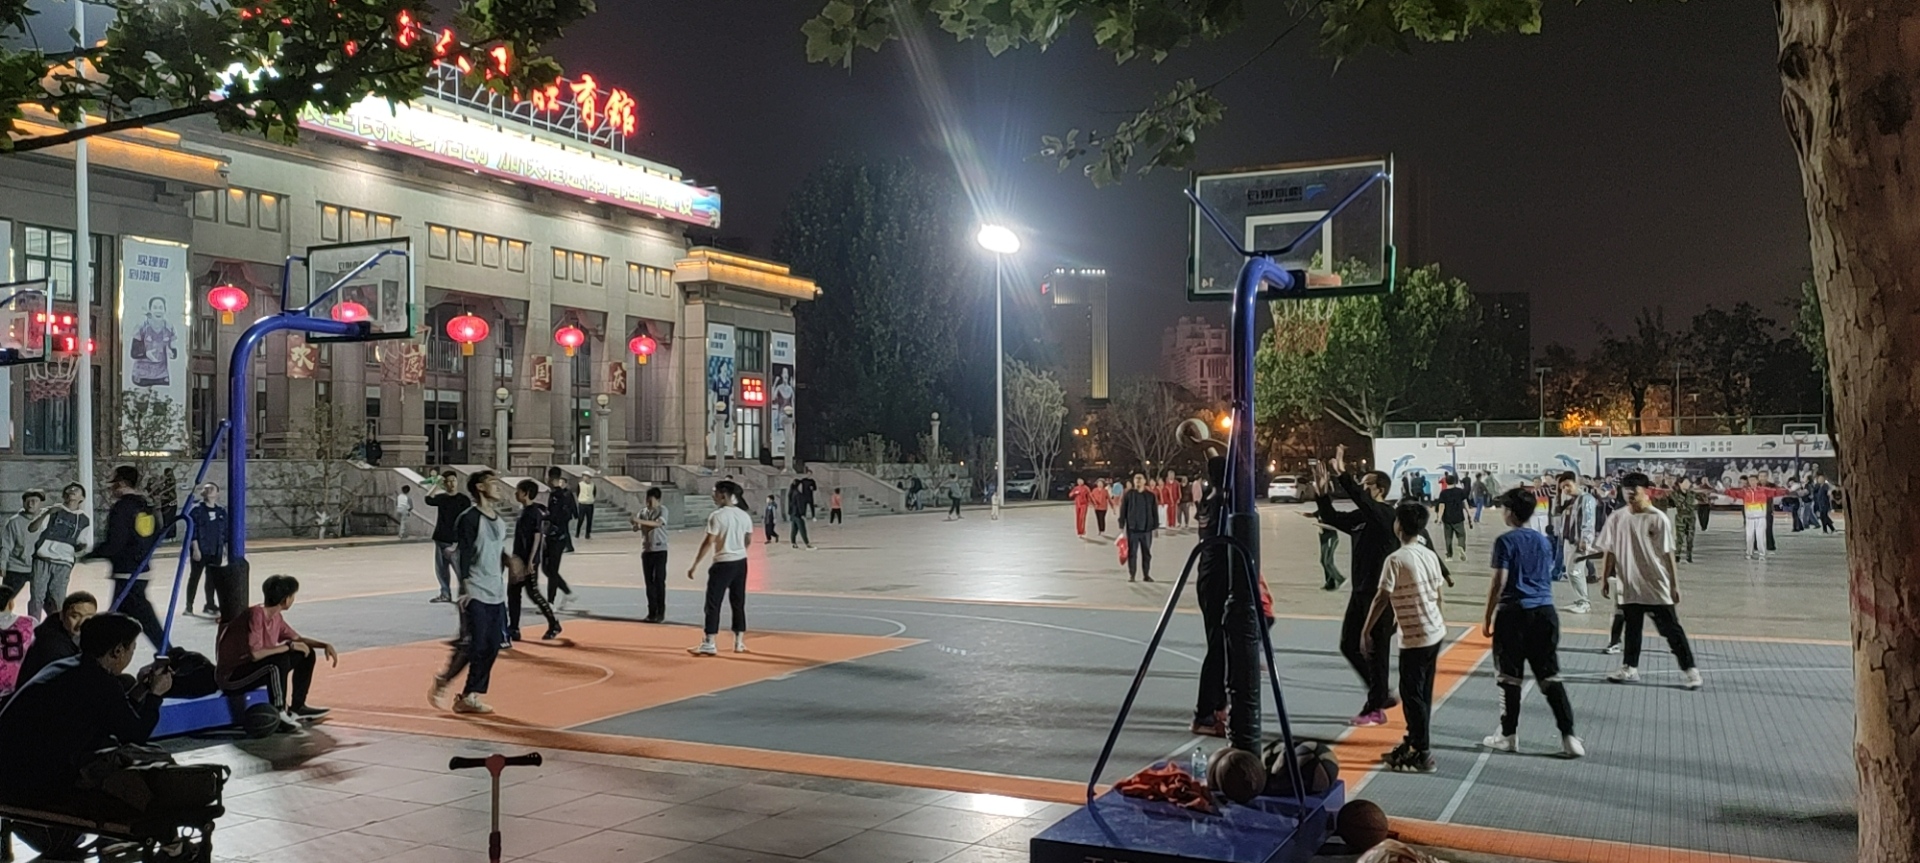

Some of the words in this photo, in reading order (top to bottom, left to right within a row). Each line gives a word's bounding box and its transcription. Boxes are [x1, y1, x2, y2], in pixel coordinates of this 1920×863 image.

[137, 254, 169, 269] 买理财
[535, 362, 550, 383] 国
